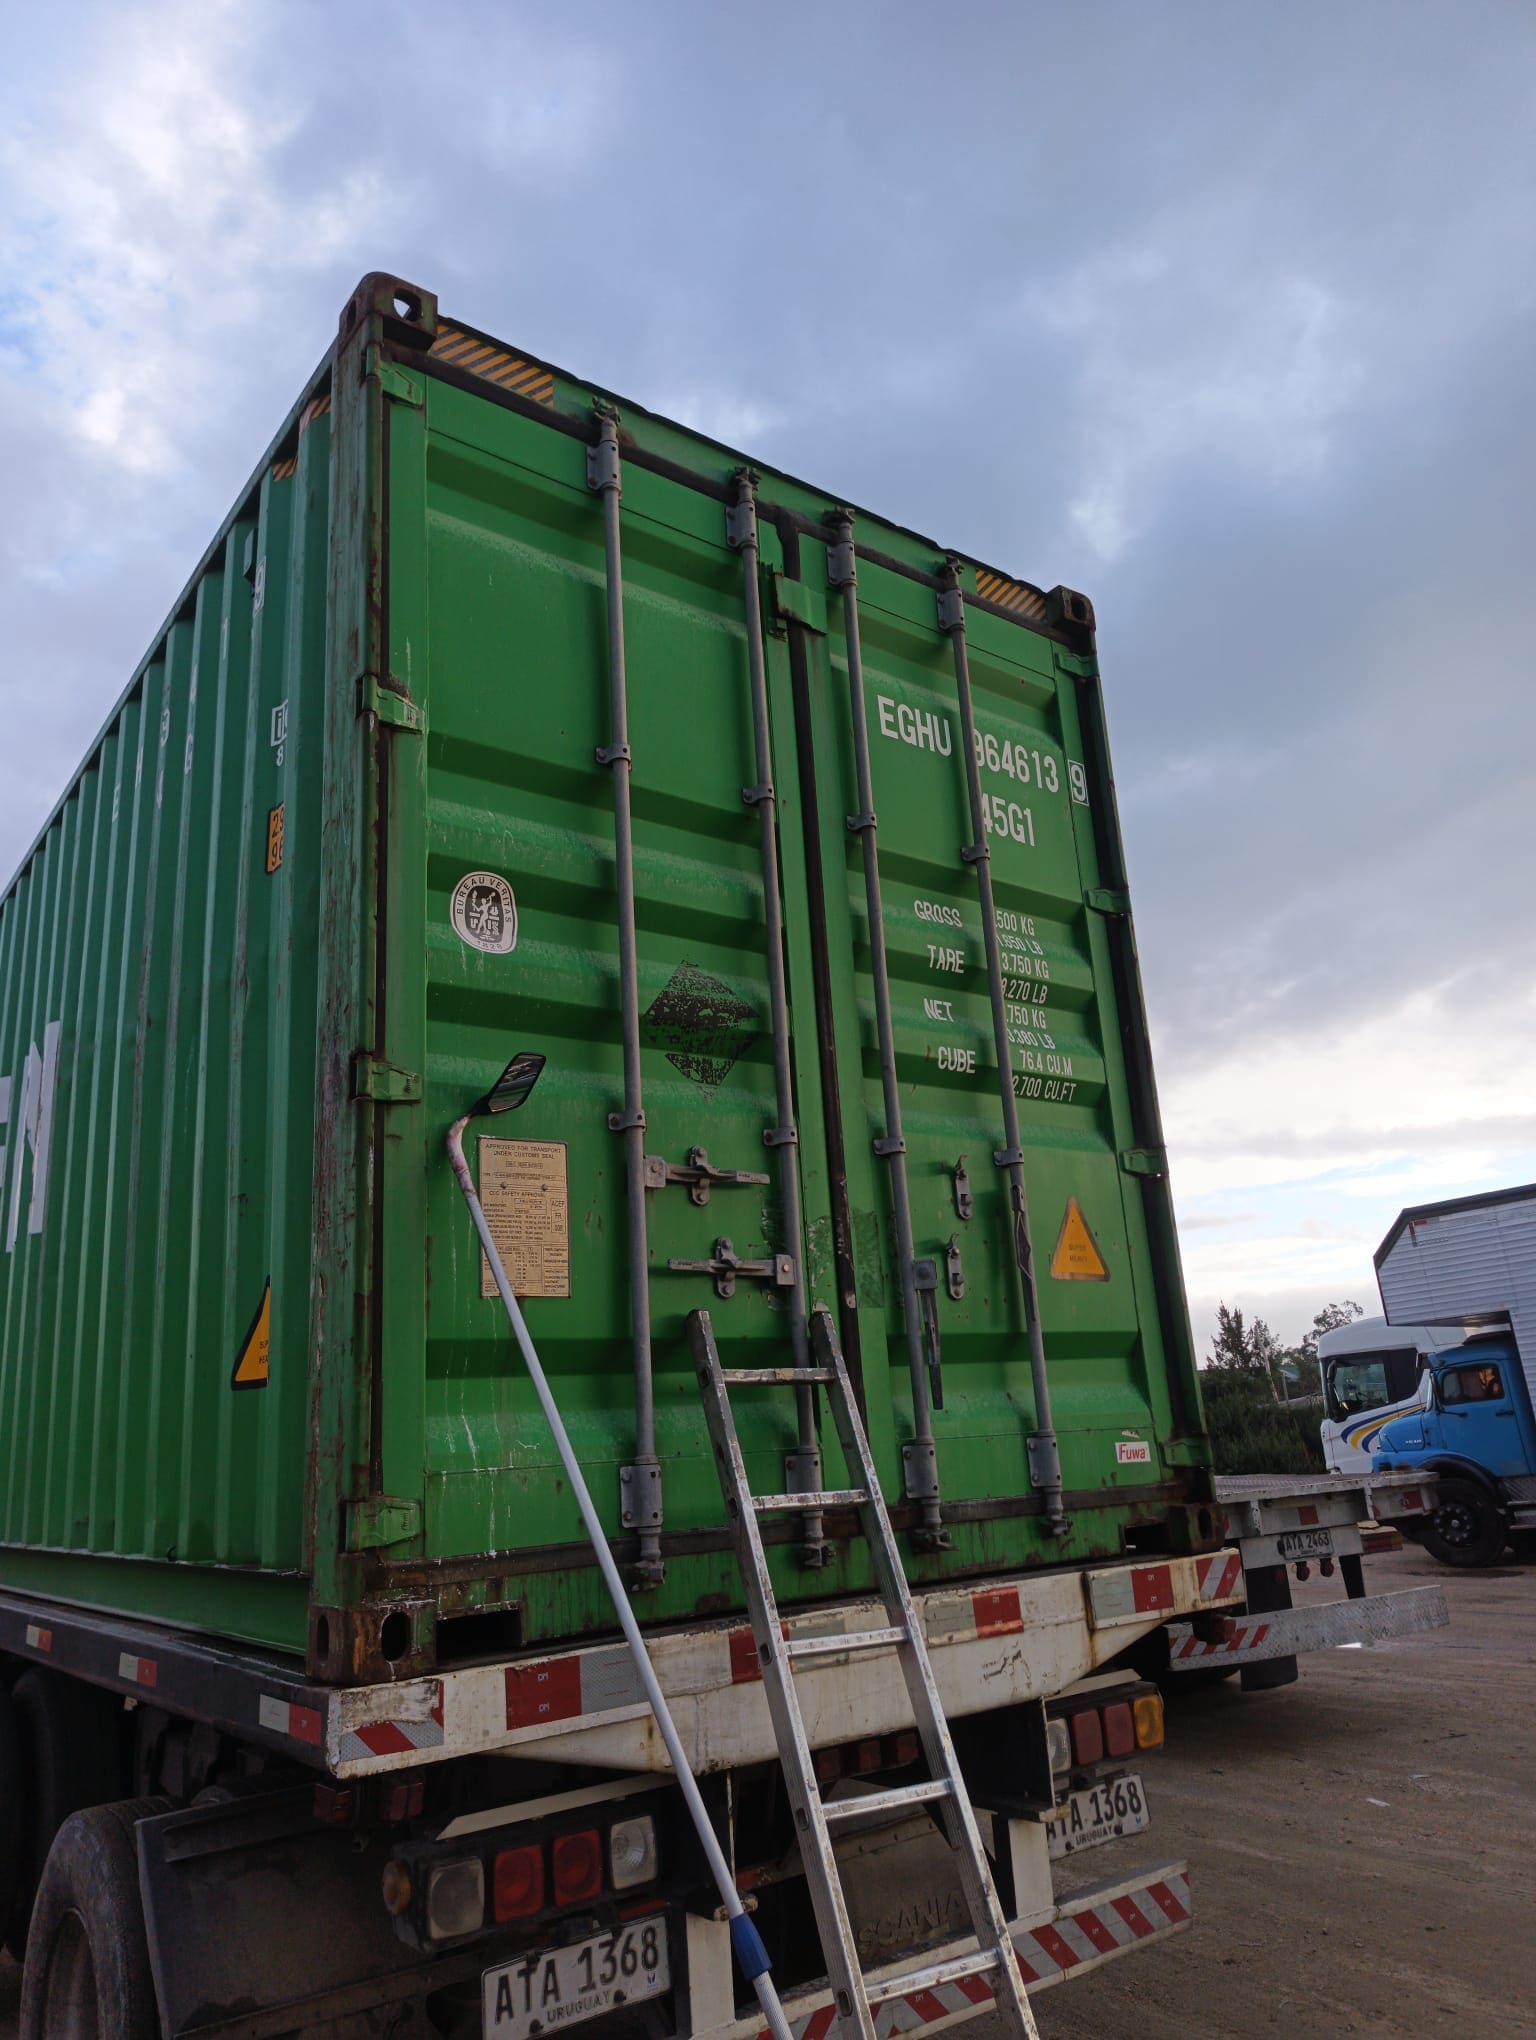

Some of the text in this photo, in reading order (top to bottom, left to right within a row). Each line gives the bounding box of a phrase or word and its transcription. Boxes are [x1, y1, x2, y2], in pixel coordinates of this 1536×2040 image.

[877, 695, 952, 757] EGHU
[1070, 763, 1087, 802] 9
[981, 793, 1035, 847] 45G1
[456, 877, 512, 923] BUREAU VERITAS
[914, 899, 1035, 937] GROSS .500 KG
[927, 944, 1050, 979] TARE 3.750 KG
[1027, 940, 1044, 956] LB
[1032, 983, 1048, 1004] LB
[923, 998, 1047, 1029] NET .750 KG
[1040, 1033, 1056, 1050] LB
[938, 1046, 1073, 1076] CUBE 76.4 CU.M
[1044, 1078, 1077, 1103] CU.FT
[485, 1143, 516, 1151] APPROVED
[1119, 1443, 1146, 1461] Fuwa
[1089, 1781, 1142, 1826] 1368
[1075, 1824, 1113, 1845] URUGUAY
[494, 1926, 659, 2025] ATA 1368
[547, 1990, 610, 2023] URUGUAY
